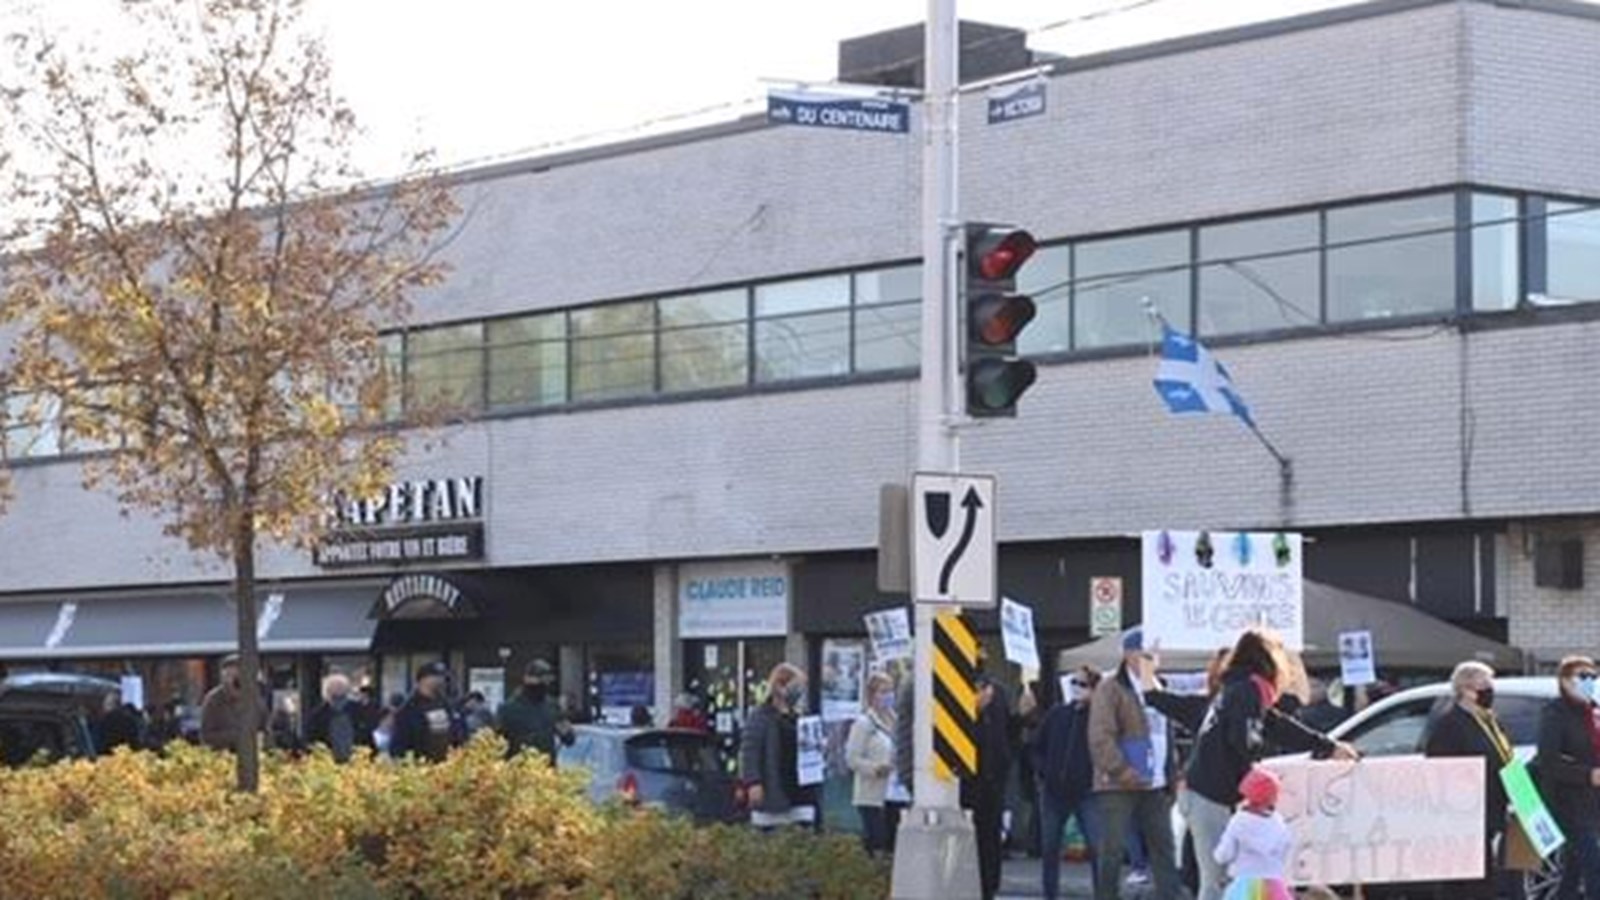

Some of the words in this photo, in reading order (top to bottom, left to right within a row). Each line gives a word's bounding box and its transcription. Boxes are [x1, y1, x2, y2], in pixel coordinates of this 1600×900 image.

[796, 106, 817, 124] DU
[820, 109, 902, 130] CENTENAIRE
[320, 476, 476, 524] APETAN
[403, 539, 421, 556] VIN
[423, 538, 435, 555] ET
[384, 574, 460, 609] RESTAURANT
[686, 579, 746, 599] CLAUDE
[750, 577, 786, 597] REID
